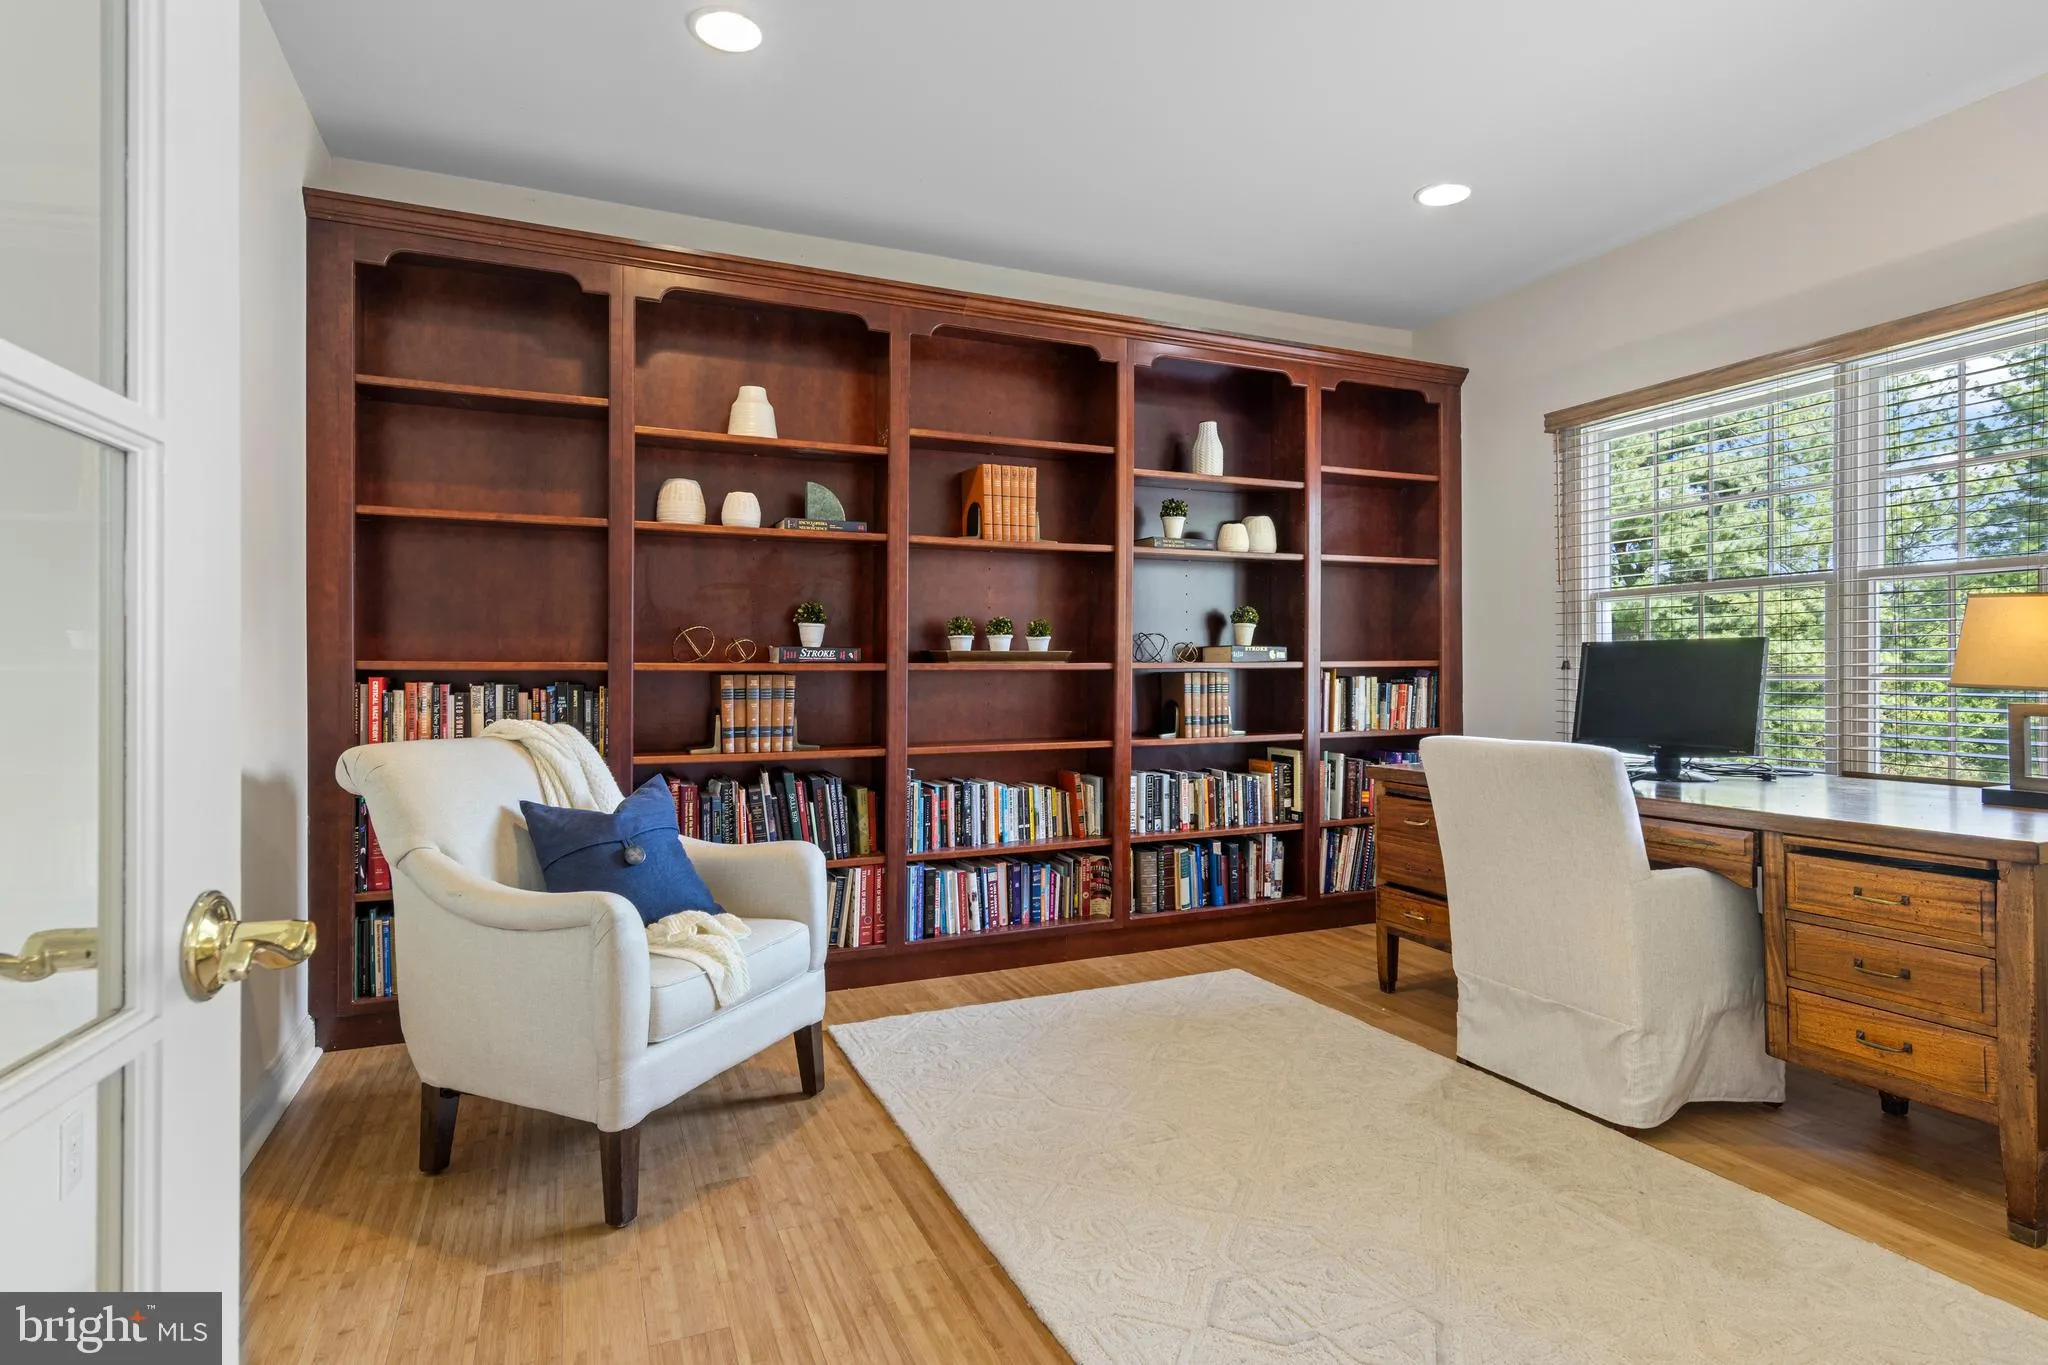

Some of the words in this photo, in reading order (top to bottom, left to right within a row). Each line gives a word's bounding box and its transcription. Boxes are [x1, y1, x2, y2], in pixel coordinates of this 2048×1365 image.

[800, 648, 836, 658] STROKE
[455, 701, 464, 714] RED
[371, 721, 379, 742] THEORY
[455, 715, 464, 738] SUMME
[788, 793, 797, 811] SKULL
[791, 810, 799, 823] 1979
